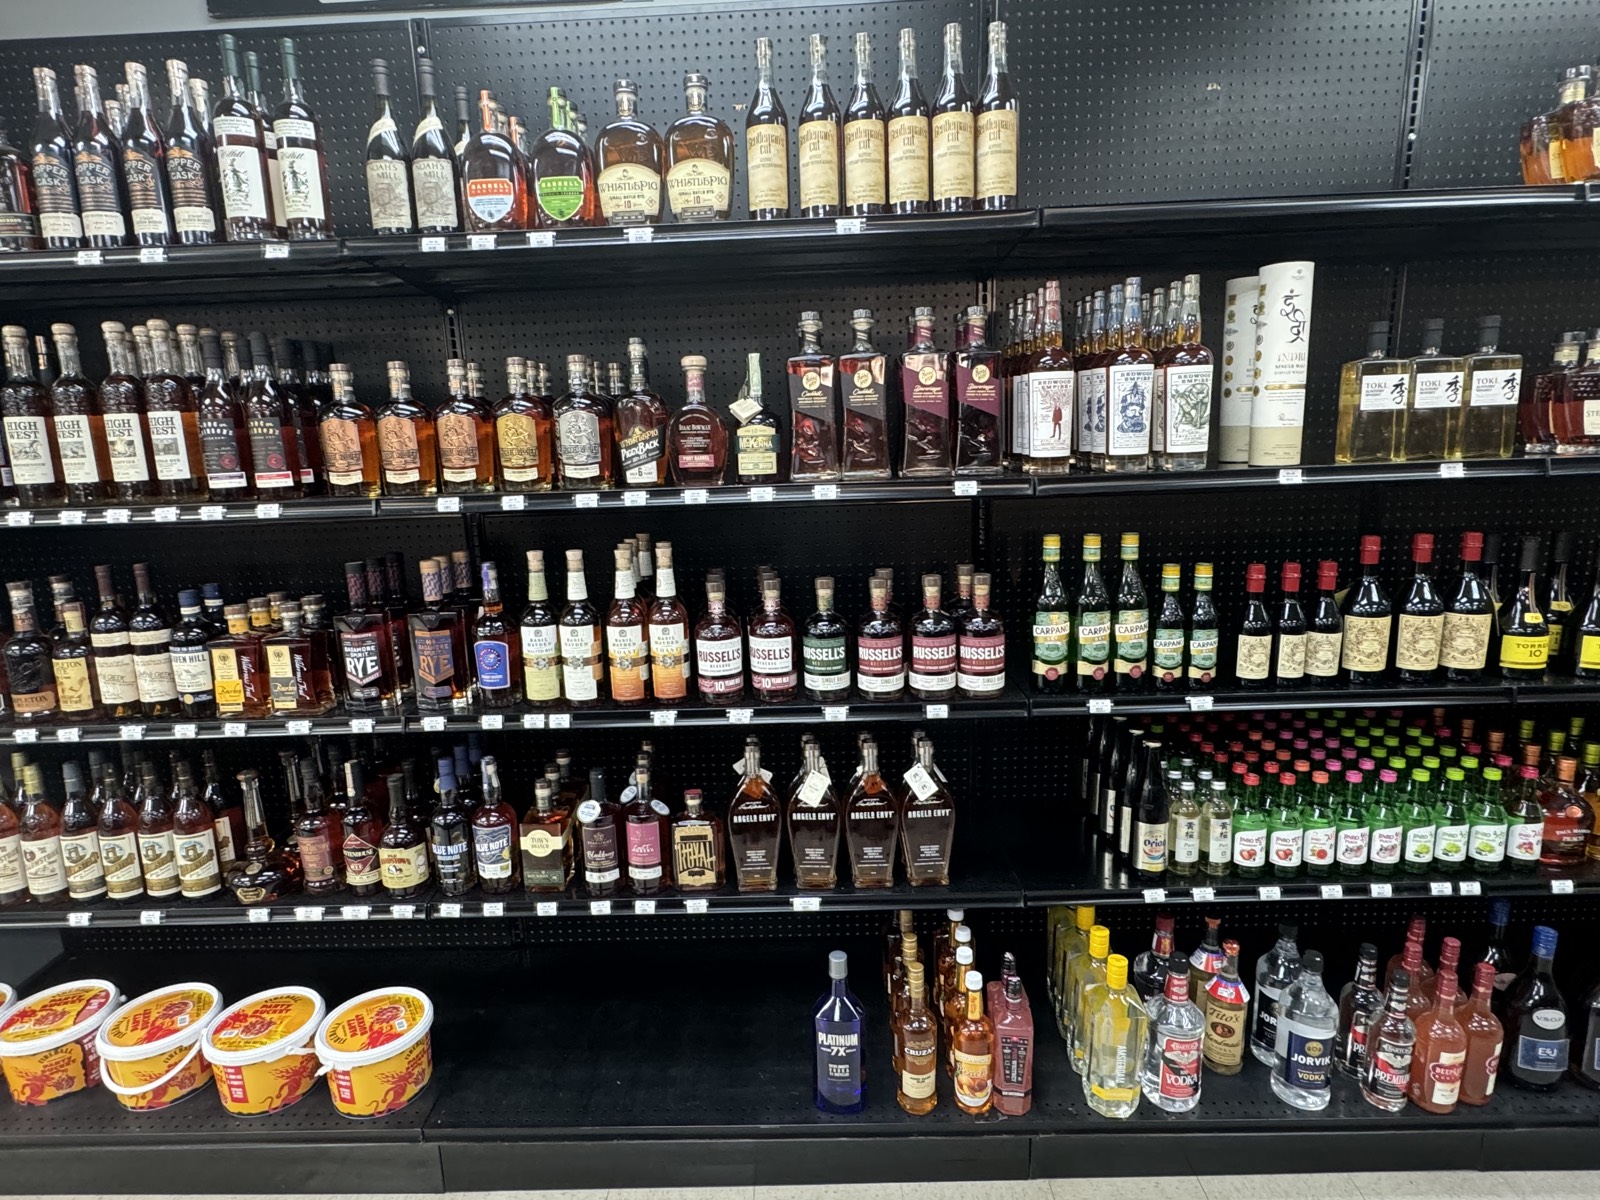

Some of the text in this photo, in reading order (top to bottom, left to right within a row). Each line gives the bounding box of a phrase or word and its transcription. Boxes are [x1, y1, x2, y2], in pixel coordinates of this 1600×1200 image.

[377, 172, 398, 181] MILL
[424, 171, 446, 180] MILL
[471, 183, 510, 191] BARRELL
[624, 200, 632, 209] 10
[693, 195, 701, 204] 10
[1365, 382, 1388, 390] TOKI
[1477, 377, 1498, 385] TOKI
[7, 421, 37, 431] HIGH
[638, 468, 643, 477] 6
[698, 647, 741, 662] RUSSELL'S
[859, 646, 902, 661] RUSSELL'S
[913, 644, 957, 660] RUSSELL'S
[960, 645, 1005, 660] RUSSELL'S
[1529, 649, 1542, 658] 10
[189, 654, 207, 662] HILL
[346, 656, 379, 678] RYE
[419, 654, 452, 676] RYE
[714, 680, 725, 691] 10
[761, 678, 772, 689] 10
[759, 813, 777, 823] ENVY
[818, 812, 836, 821] ENVY
[876, 811, 895, 820] ENVY
[933, 809, 952, 818] ENVY
[432, 842, 468, 855] BLUE NOTE
[489, 838, 508, 850] NOTE
[1209, 1006, 1241, 1023] Tito's
[1259, 1011, 1277, 1024] JOR
[355, 1013, 368, 1036] BUCKET
[818, 1032, 859, 1046] PLATINUM
[1205, 1031, 1240, 1048] Handmade
[38, 1048, 74, 1064] FIREBALL
[830, 1046, 847, 1056] 7X
[1538, 1047, 1558, 1056] E&J
[1291, 1053, 1331, 1066] JORVIK
[1166, 1073, 1198, 1085] VODKA
[1298, 1071, 1324, 1080] VODKA
